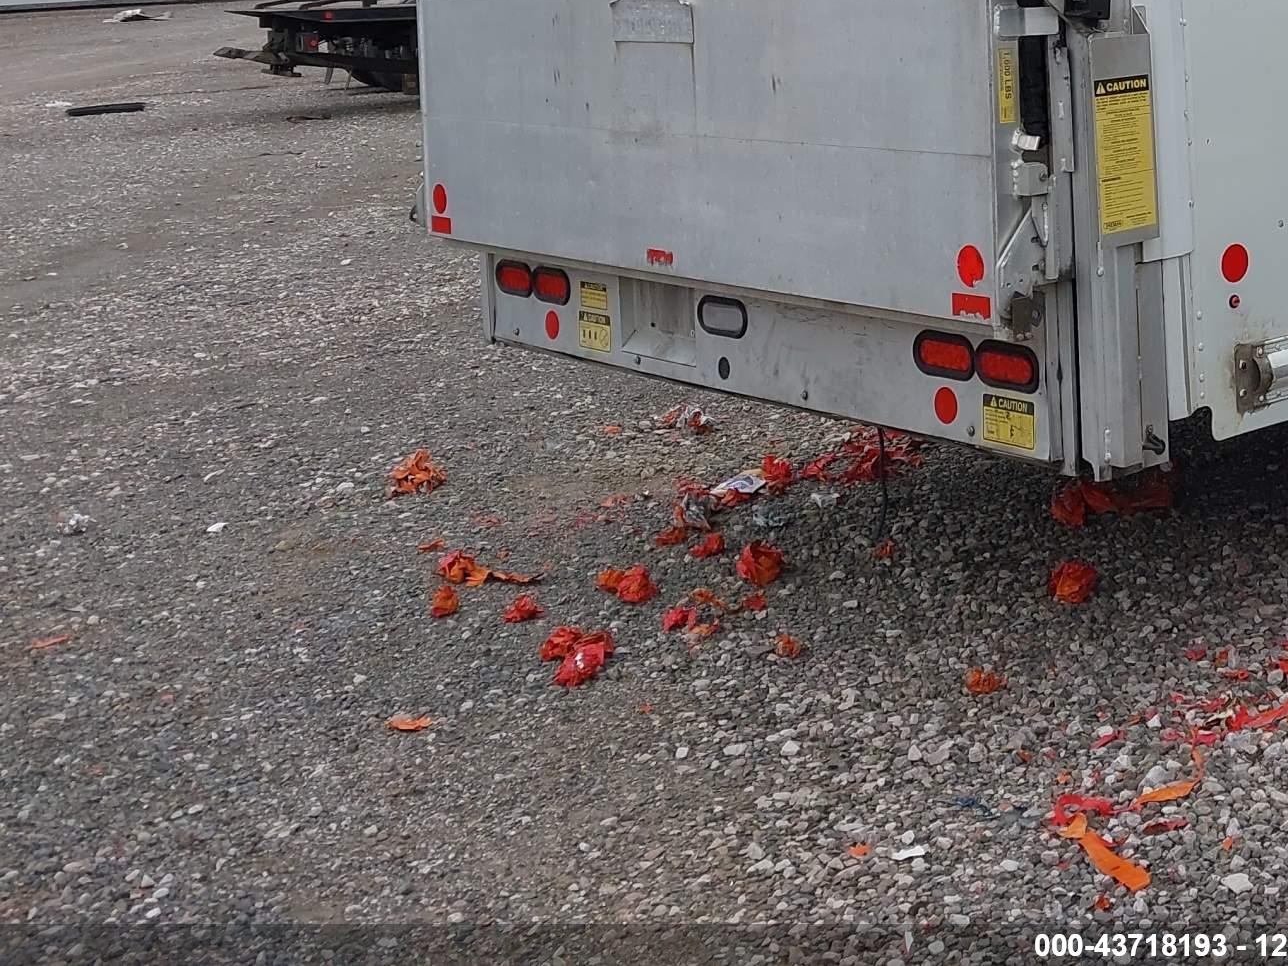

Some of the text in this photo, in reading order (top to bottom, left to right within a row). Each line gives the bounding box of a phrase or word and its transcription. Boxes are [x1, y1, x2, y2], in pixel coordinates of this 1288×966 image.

[1004, 79, 1012, 100] LBS
[1106, 78, 1147, 92] CAUTION
[998, 398, 1028, 413] CAUTION
